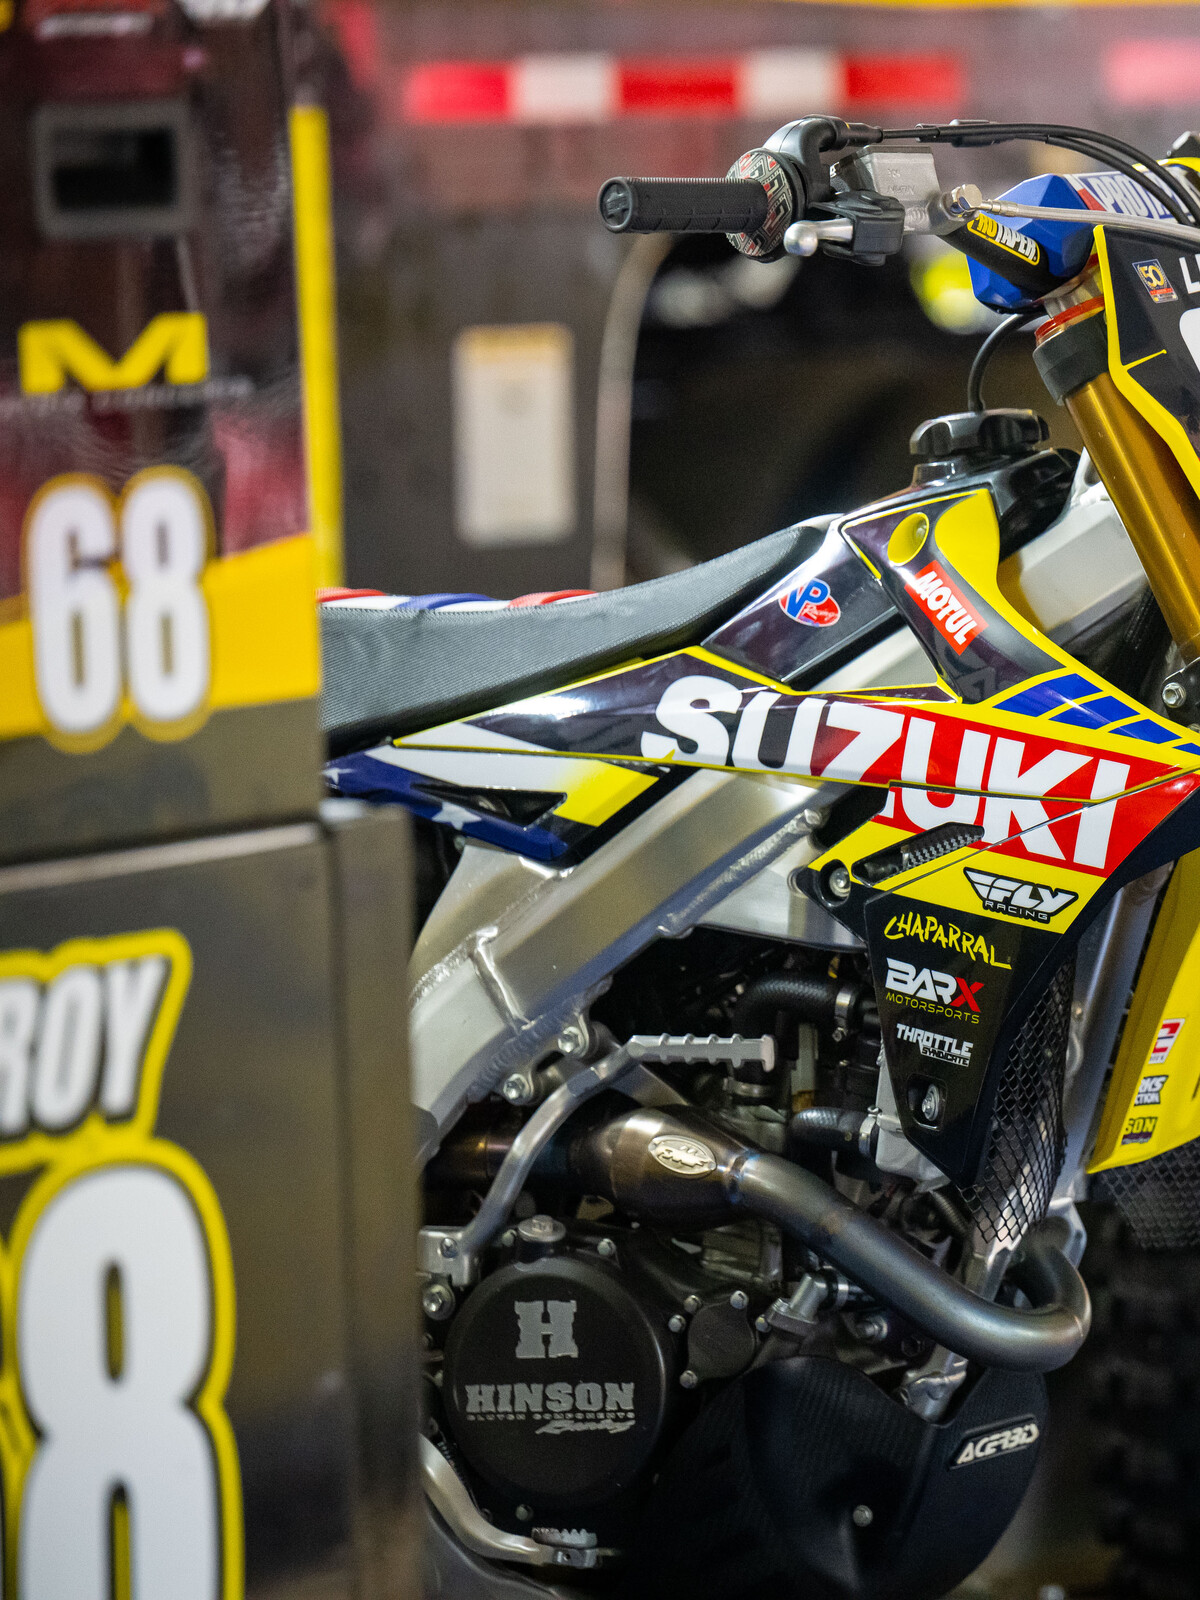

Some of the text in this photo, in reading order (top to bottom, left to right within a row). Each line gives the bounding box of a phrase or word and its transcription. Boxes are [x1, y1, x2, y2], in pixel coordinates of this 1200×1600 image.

[1140, 265, 1165, 288] 50
[17, 312, 209, 393] M
[27, 474, 208, 735] 68
[786, 578, 831, 618] VP
[913, 570, 979, 646] MOTUL
[641, 675, 1132, 869] SUZUKI
[966, 869, 1077, 914] FLY
[984, 900, 1048, 921] RACING
[884, 911, 1012, 970] CHAPARRAL
[885, 957, 984, 1012] BARX
[886, 992, 980, 1024] MOTORSPORTS
[896, 1023, 974, 1057] THROTTLE
[514, 1300, 579, 1359] H
[465, 1382, 635, 1412] HINSON
